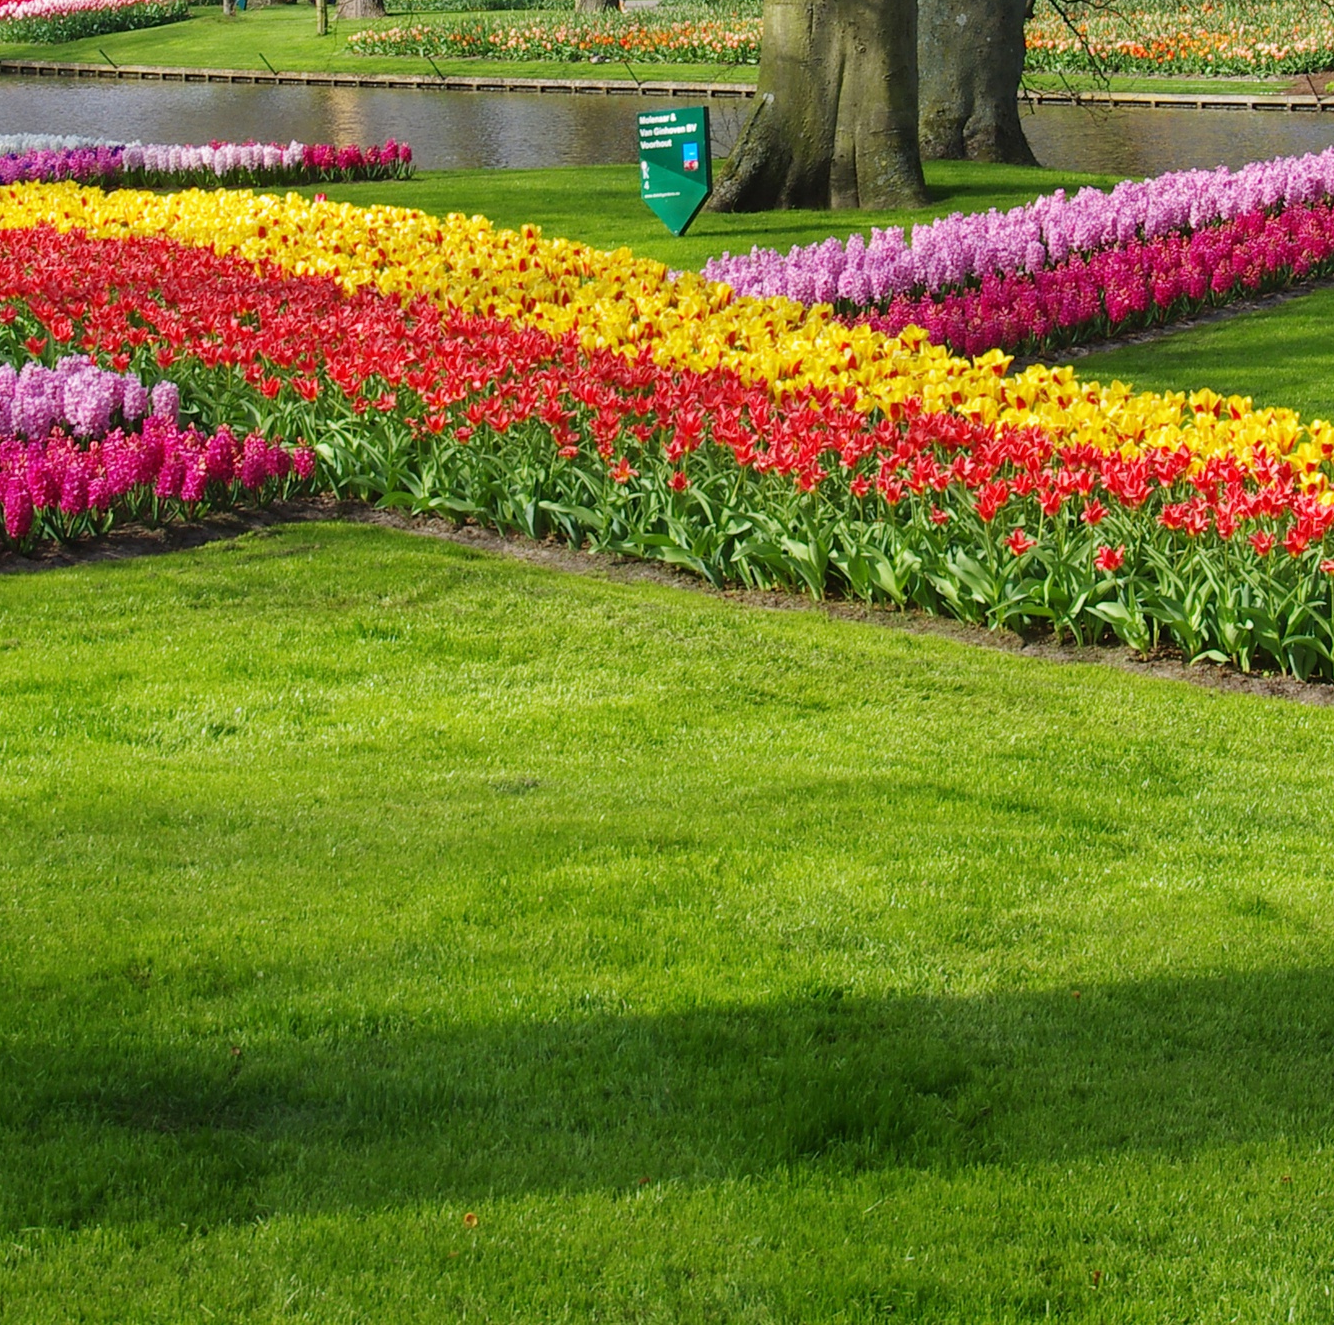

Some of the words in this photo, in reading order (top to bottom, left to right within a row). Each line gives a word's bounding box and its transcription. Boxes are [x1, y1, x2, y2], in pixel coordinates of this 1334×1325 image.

[639, 115, 669, 124] Molenaar
[670, 113, 676, 122] &
[639, 128, 653, 137] Van
[686, 123, 697, 133] BV
[640, 139, 672, 150] Voorhout
[643, 180, 650, 190] 4
